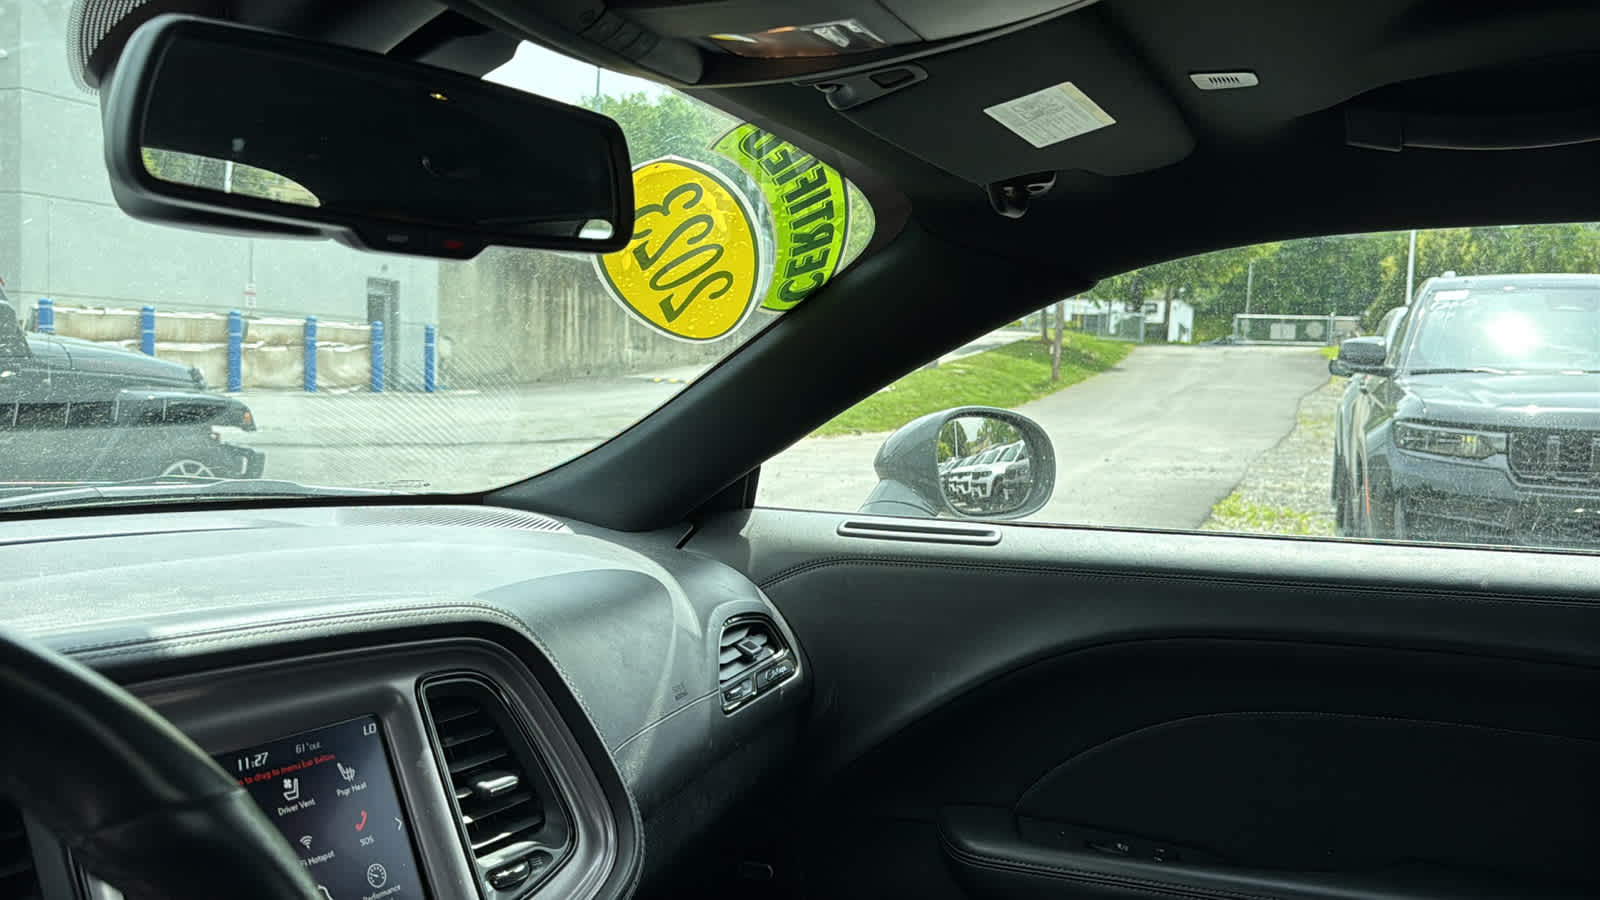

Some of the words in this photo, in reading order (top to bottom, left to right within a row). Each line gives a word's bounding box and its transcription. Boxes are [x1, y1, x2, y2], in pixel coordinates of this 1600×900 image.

[363, 723, 377, 736] LO
[238, 752, 269, 772] 11:27
[277, 802, 299, 817] Driver
[299, 798, 316, 811] Vent
[359, 835, 375, 848] SOS
[308, 850, 336, 867] Hotspot
